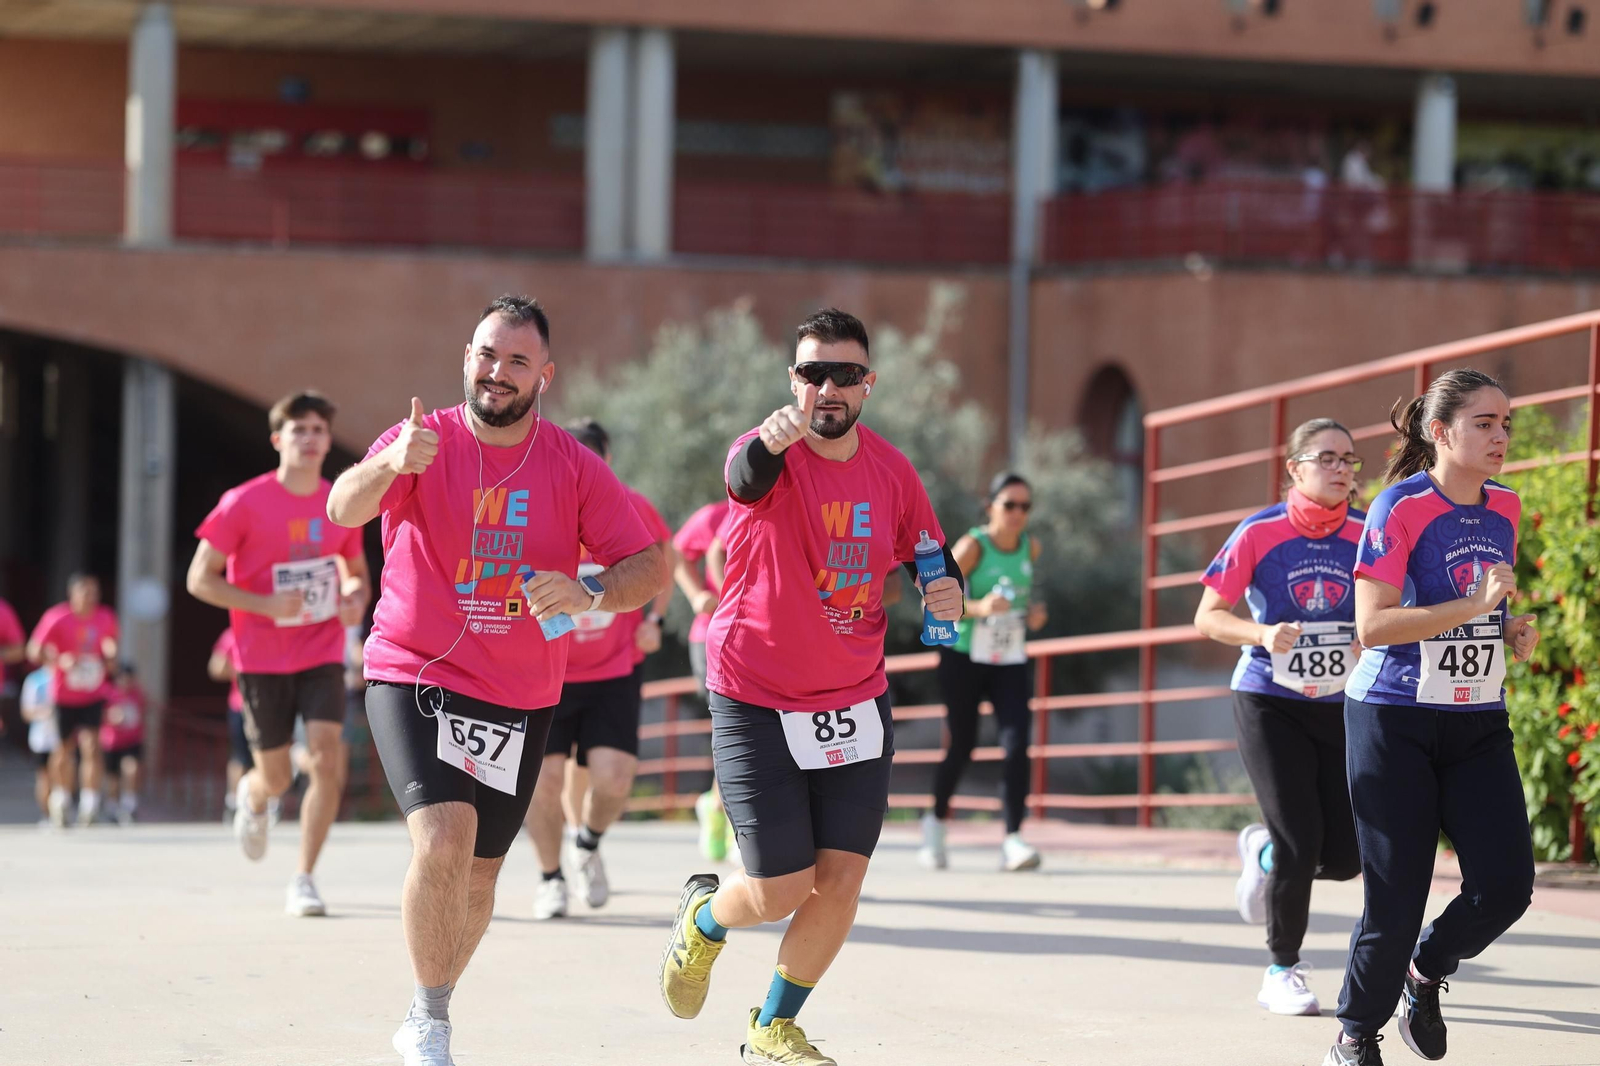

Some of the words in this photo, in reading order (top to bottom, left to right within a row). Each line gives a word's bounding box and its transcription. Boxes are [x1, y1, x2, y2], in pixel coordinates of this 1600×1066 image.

[473, 487, 529, 527] WE
[821, 501, 872, 538] WE
[287, 518, 323, 542] WE
[474, 531, 523, 559] RUN
[454, 558, 532, 597] UMA
[1288, 650, 1346, 678] 488
[1438, 644, 1495, 678] 487
[1455, 690, 1471, 699] WE
[812, 705, 857, 743] 85
[450, 718, 511, 762] 657
[465, 760, 476, 773] WE
[826, 752, 843, 763] WE
